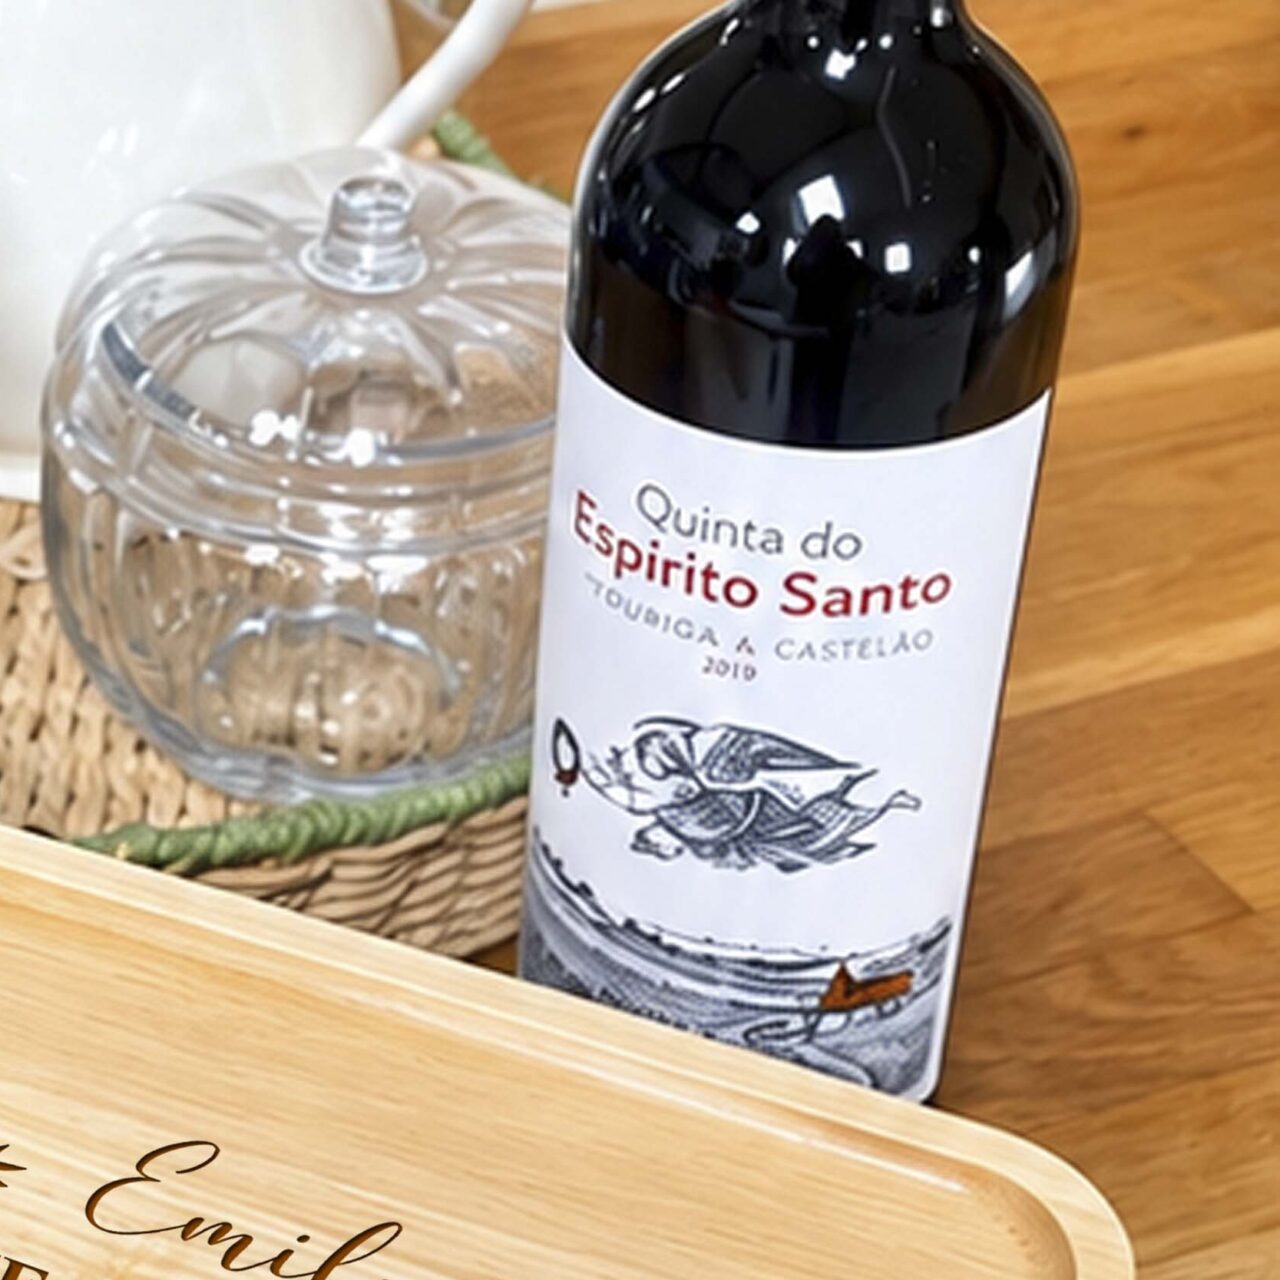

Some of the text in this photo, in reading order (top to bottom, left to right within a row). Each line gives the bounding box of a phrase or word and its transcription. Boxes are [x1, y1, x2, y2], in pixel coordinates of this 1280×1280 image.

[573, 489, 952, 618] Espirito Santo
[636, 484, 863, 560] Quinta do
